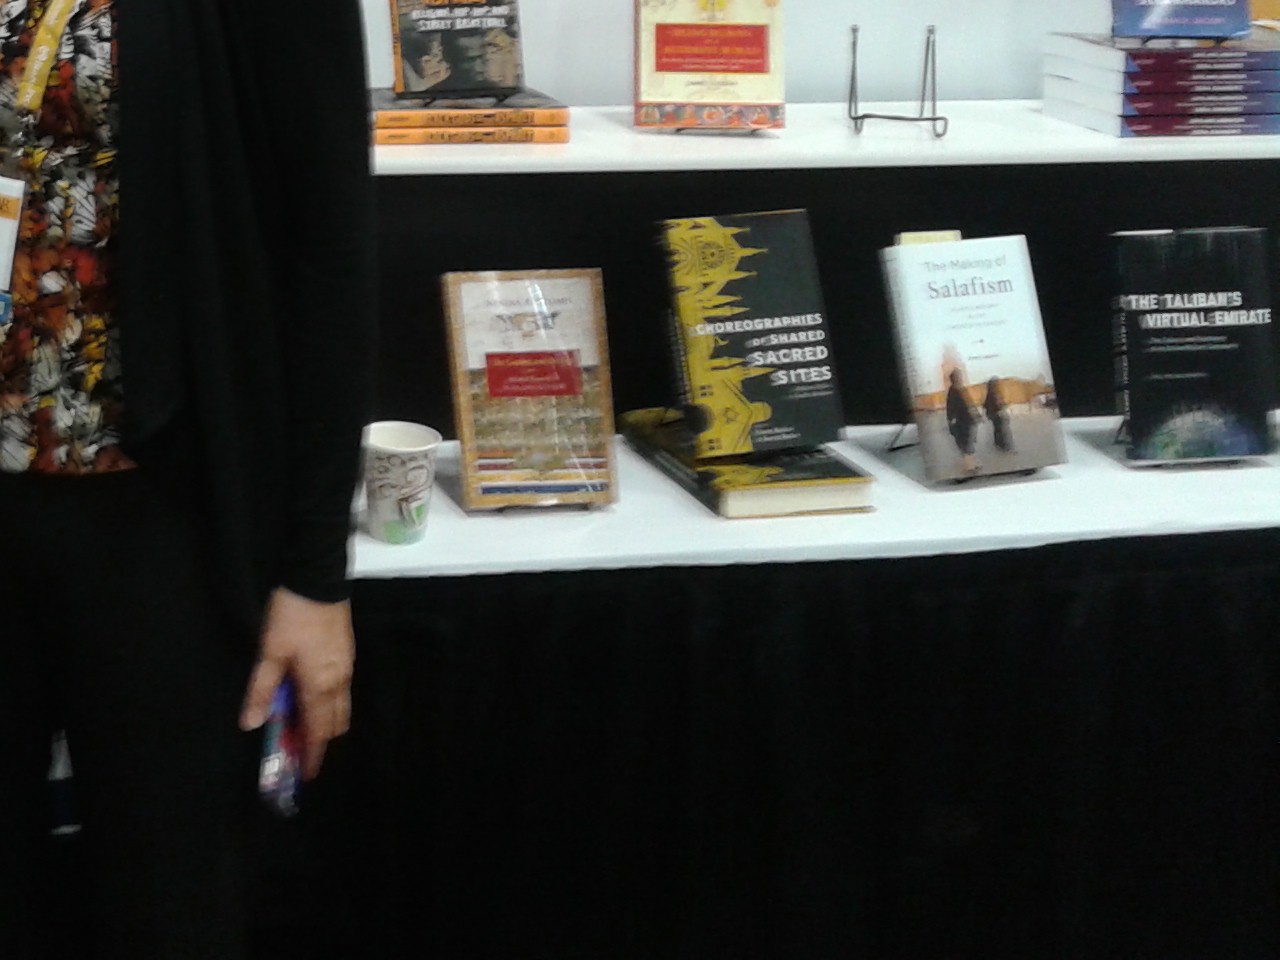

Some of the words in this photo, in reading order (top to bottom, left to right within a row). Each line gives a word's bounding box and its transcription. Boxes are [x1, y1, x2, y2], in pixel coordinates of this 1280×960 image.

[924, 261, 946, 272] The
[927, 276, 1014, 300] Salafism
[1128, 294, 1159, 309] THE
[1165, 291, 1243, 308] TALIBAN'S
[694, 313, 823, 335] CHOREOGRAPHIES
[1144, 311, 1209, 328] VIRTUAL
[1215, 308, 1272, 326] EMIRATE
[752, 337, 767, 347] OF
[769, 330, 826, 345] SHARED
[751, 345, 829, 367] SACRED
[775, 365, 833, 385] SITES
